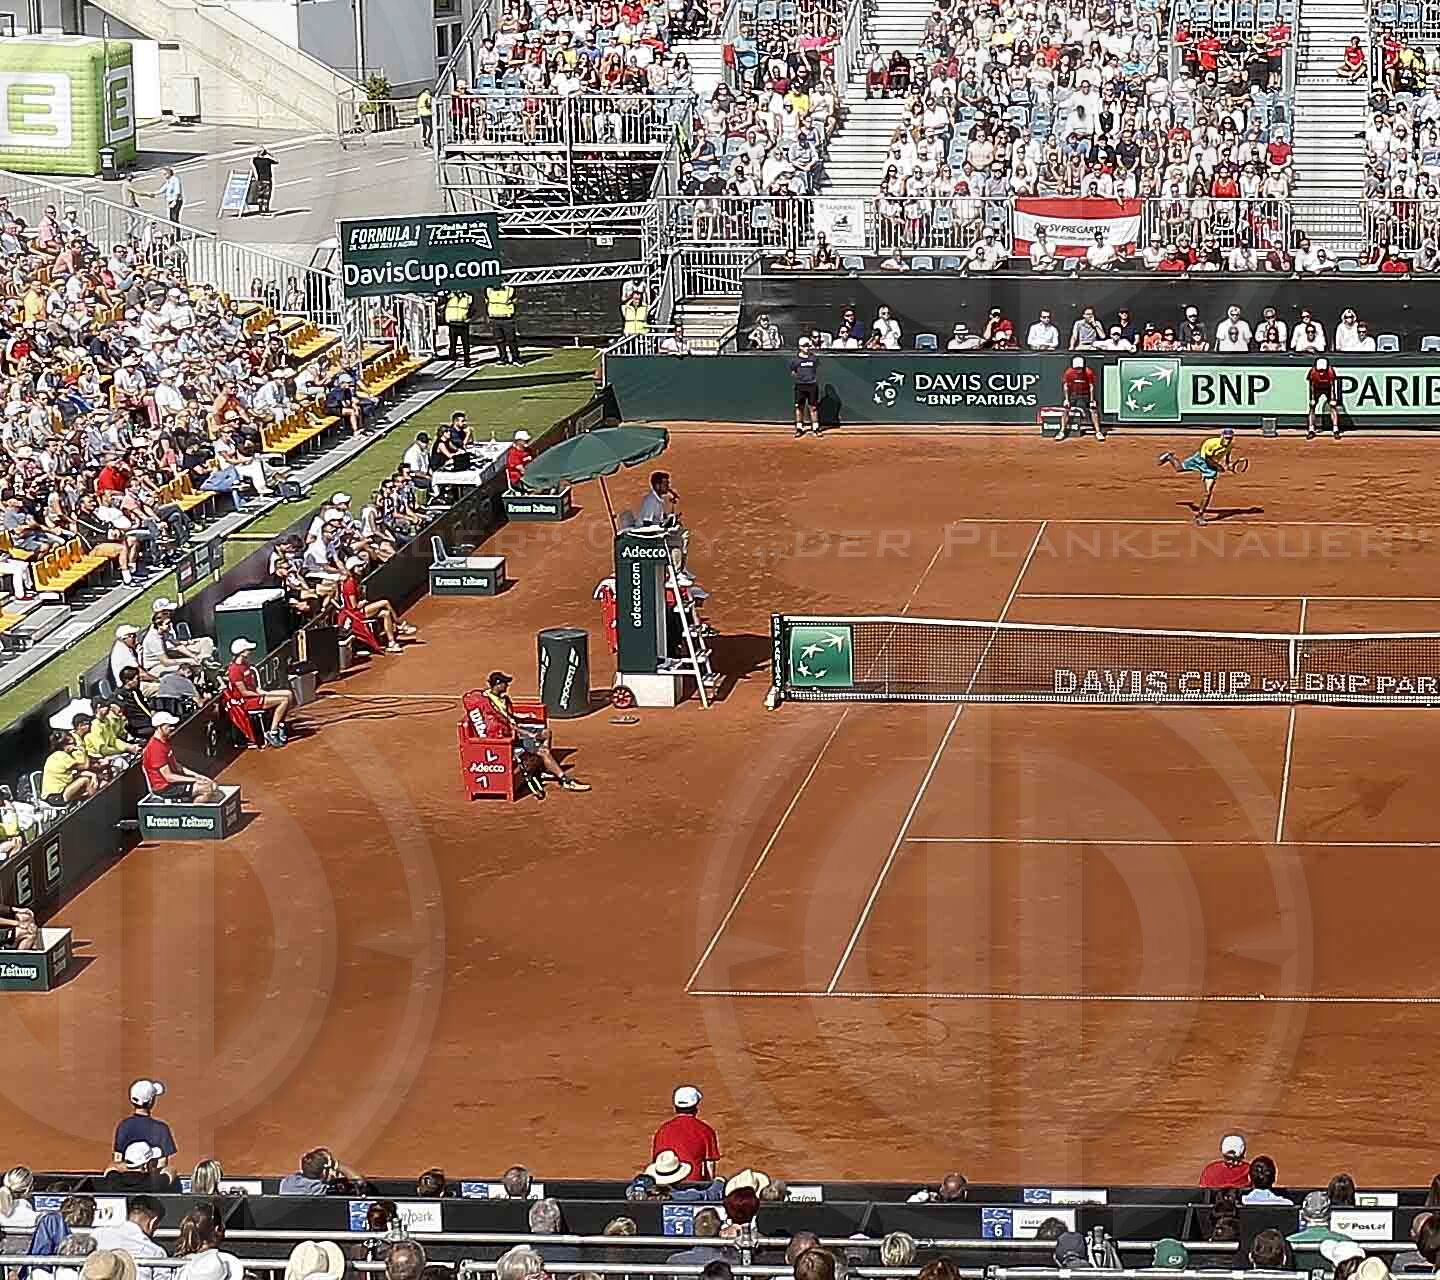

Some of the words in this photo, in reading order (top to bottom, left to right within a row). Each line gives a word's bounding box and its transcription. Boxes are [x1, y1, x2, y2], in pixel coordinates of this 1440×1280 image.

[350, 225, 410, 245] FORMULA
[413, 224, 421, 240] 1
[344, 259, 500, 286] DavisCup.com
[914, 373, 981, 391] DAVIS
[988, 374, 1037, 391] CUP
[1190, 373, 1272, 406] BNP
[927, 394, 963, 406] BNP
[966, 394, 1037, 406] PARIBAS
[622, 545, 666, 559] Adecco
[1054, 669, 1168, 695] DAVIS
[1179, 671, 1251, 695] CUP
[1305, 672, 1370, 693] BNP
[470, 762, 505, 773] Adecco
[146, 815, 180, 827] Kronen
[181, 816, 214, 829] Zeitung
[0, 963, 37, 979] Zeitung
[675, 1221, 684, 1233] 5
[994, 1224, 1002, 1237] 6
